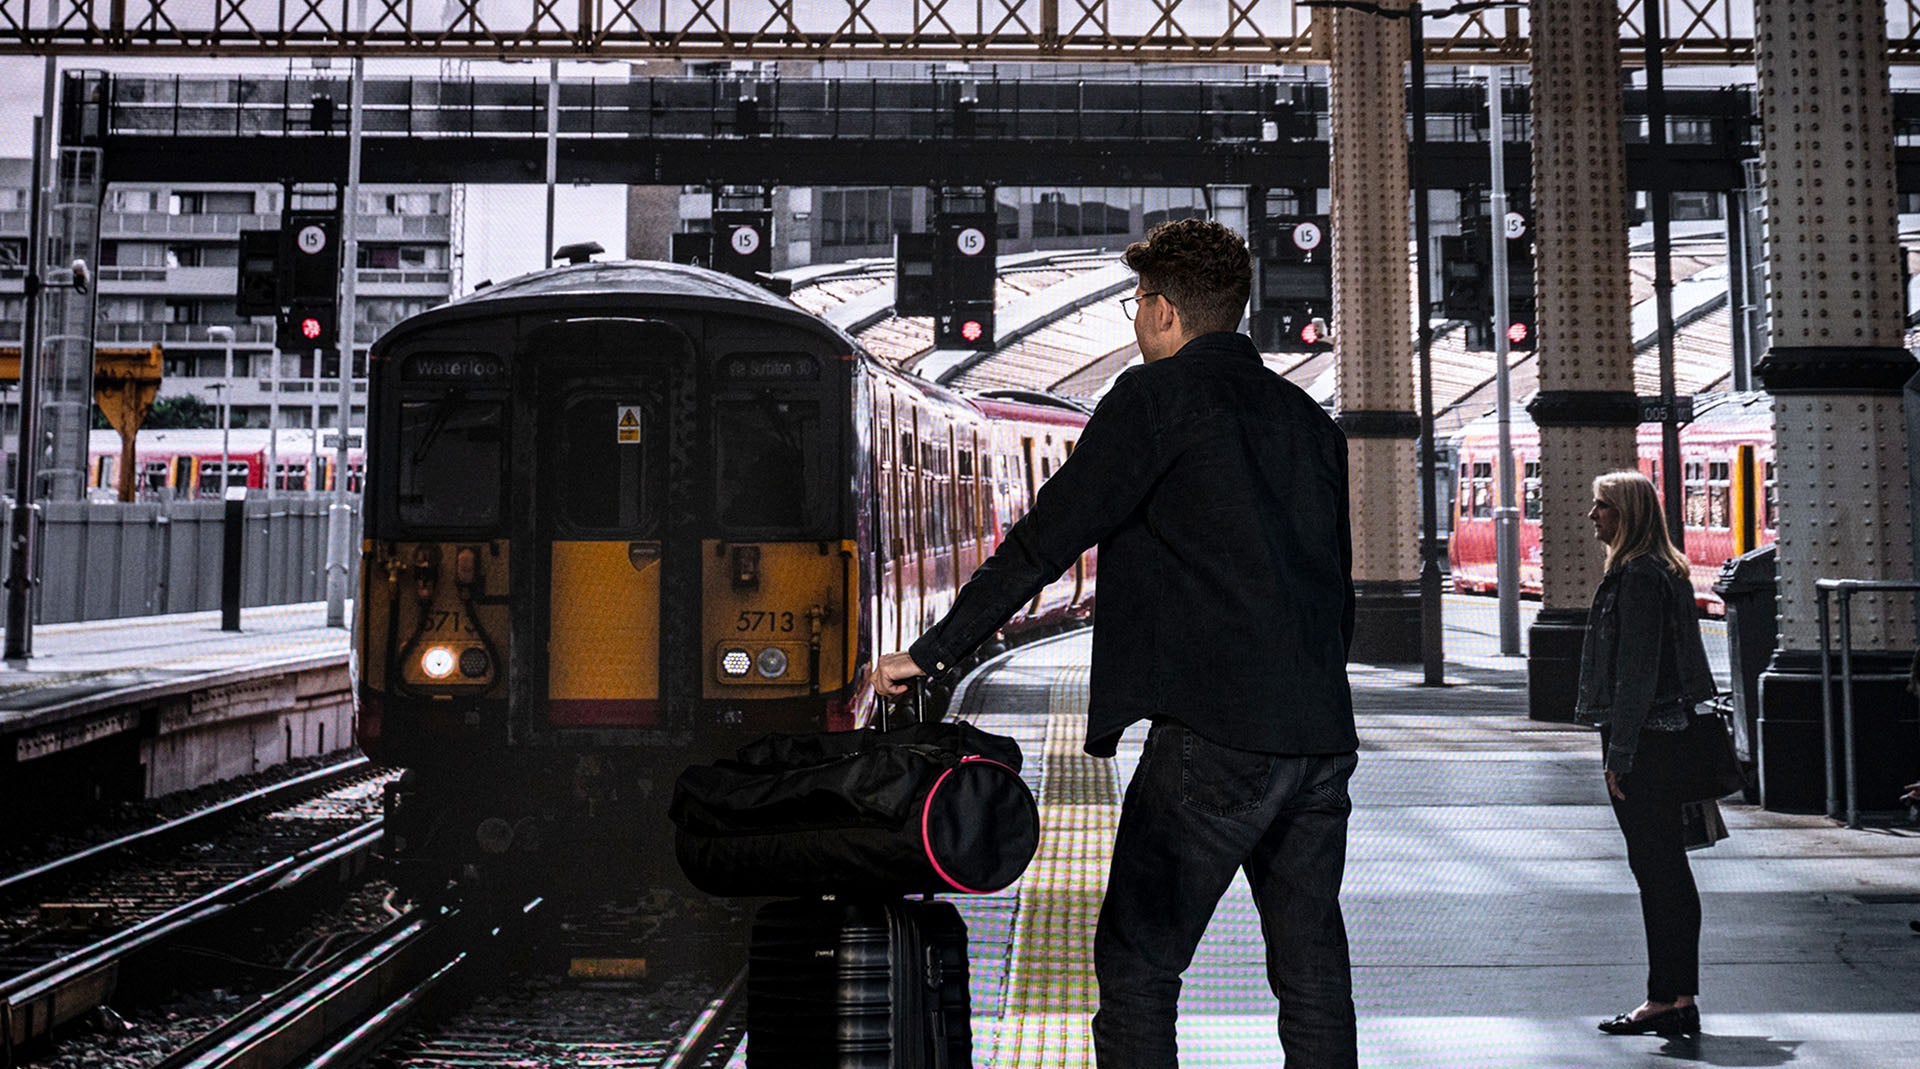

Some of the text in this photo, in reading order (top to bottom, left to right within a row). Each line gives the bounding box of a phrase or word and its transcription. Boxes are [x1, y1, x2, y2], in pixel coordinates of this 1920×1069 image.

[1507, 219, 1519, 232] 15
[305, 232, 318, 246] 15
[739, 234, 752, 248] 15
[964, 235, 977, 249] 15
[1301, 229, 1314, 243] 15
[416, 360, 497, 376] Waterloo
[1644, 407, 1668, 421] 005
[736, 611, 794, 632] 5713
